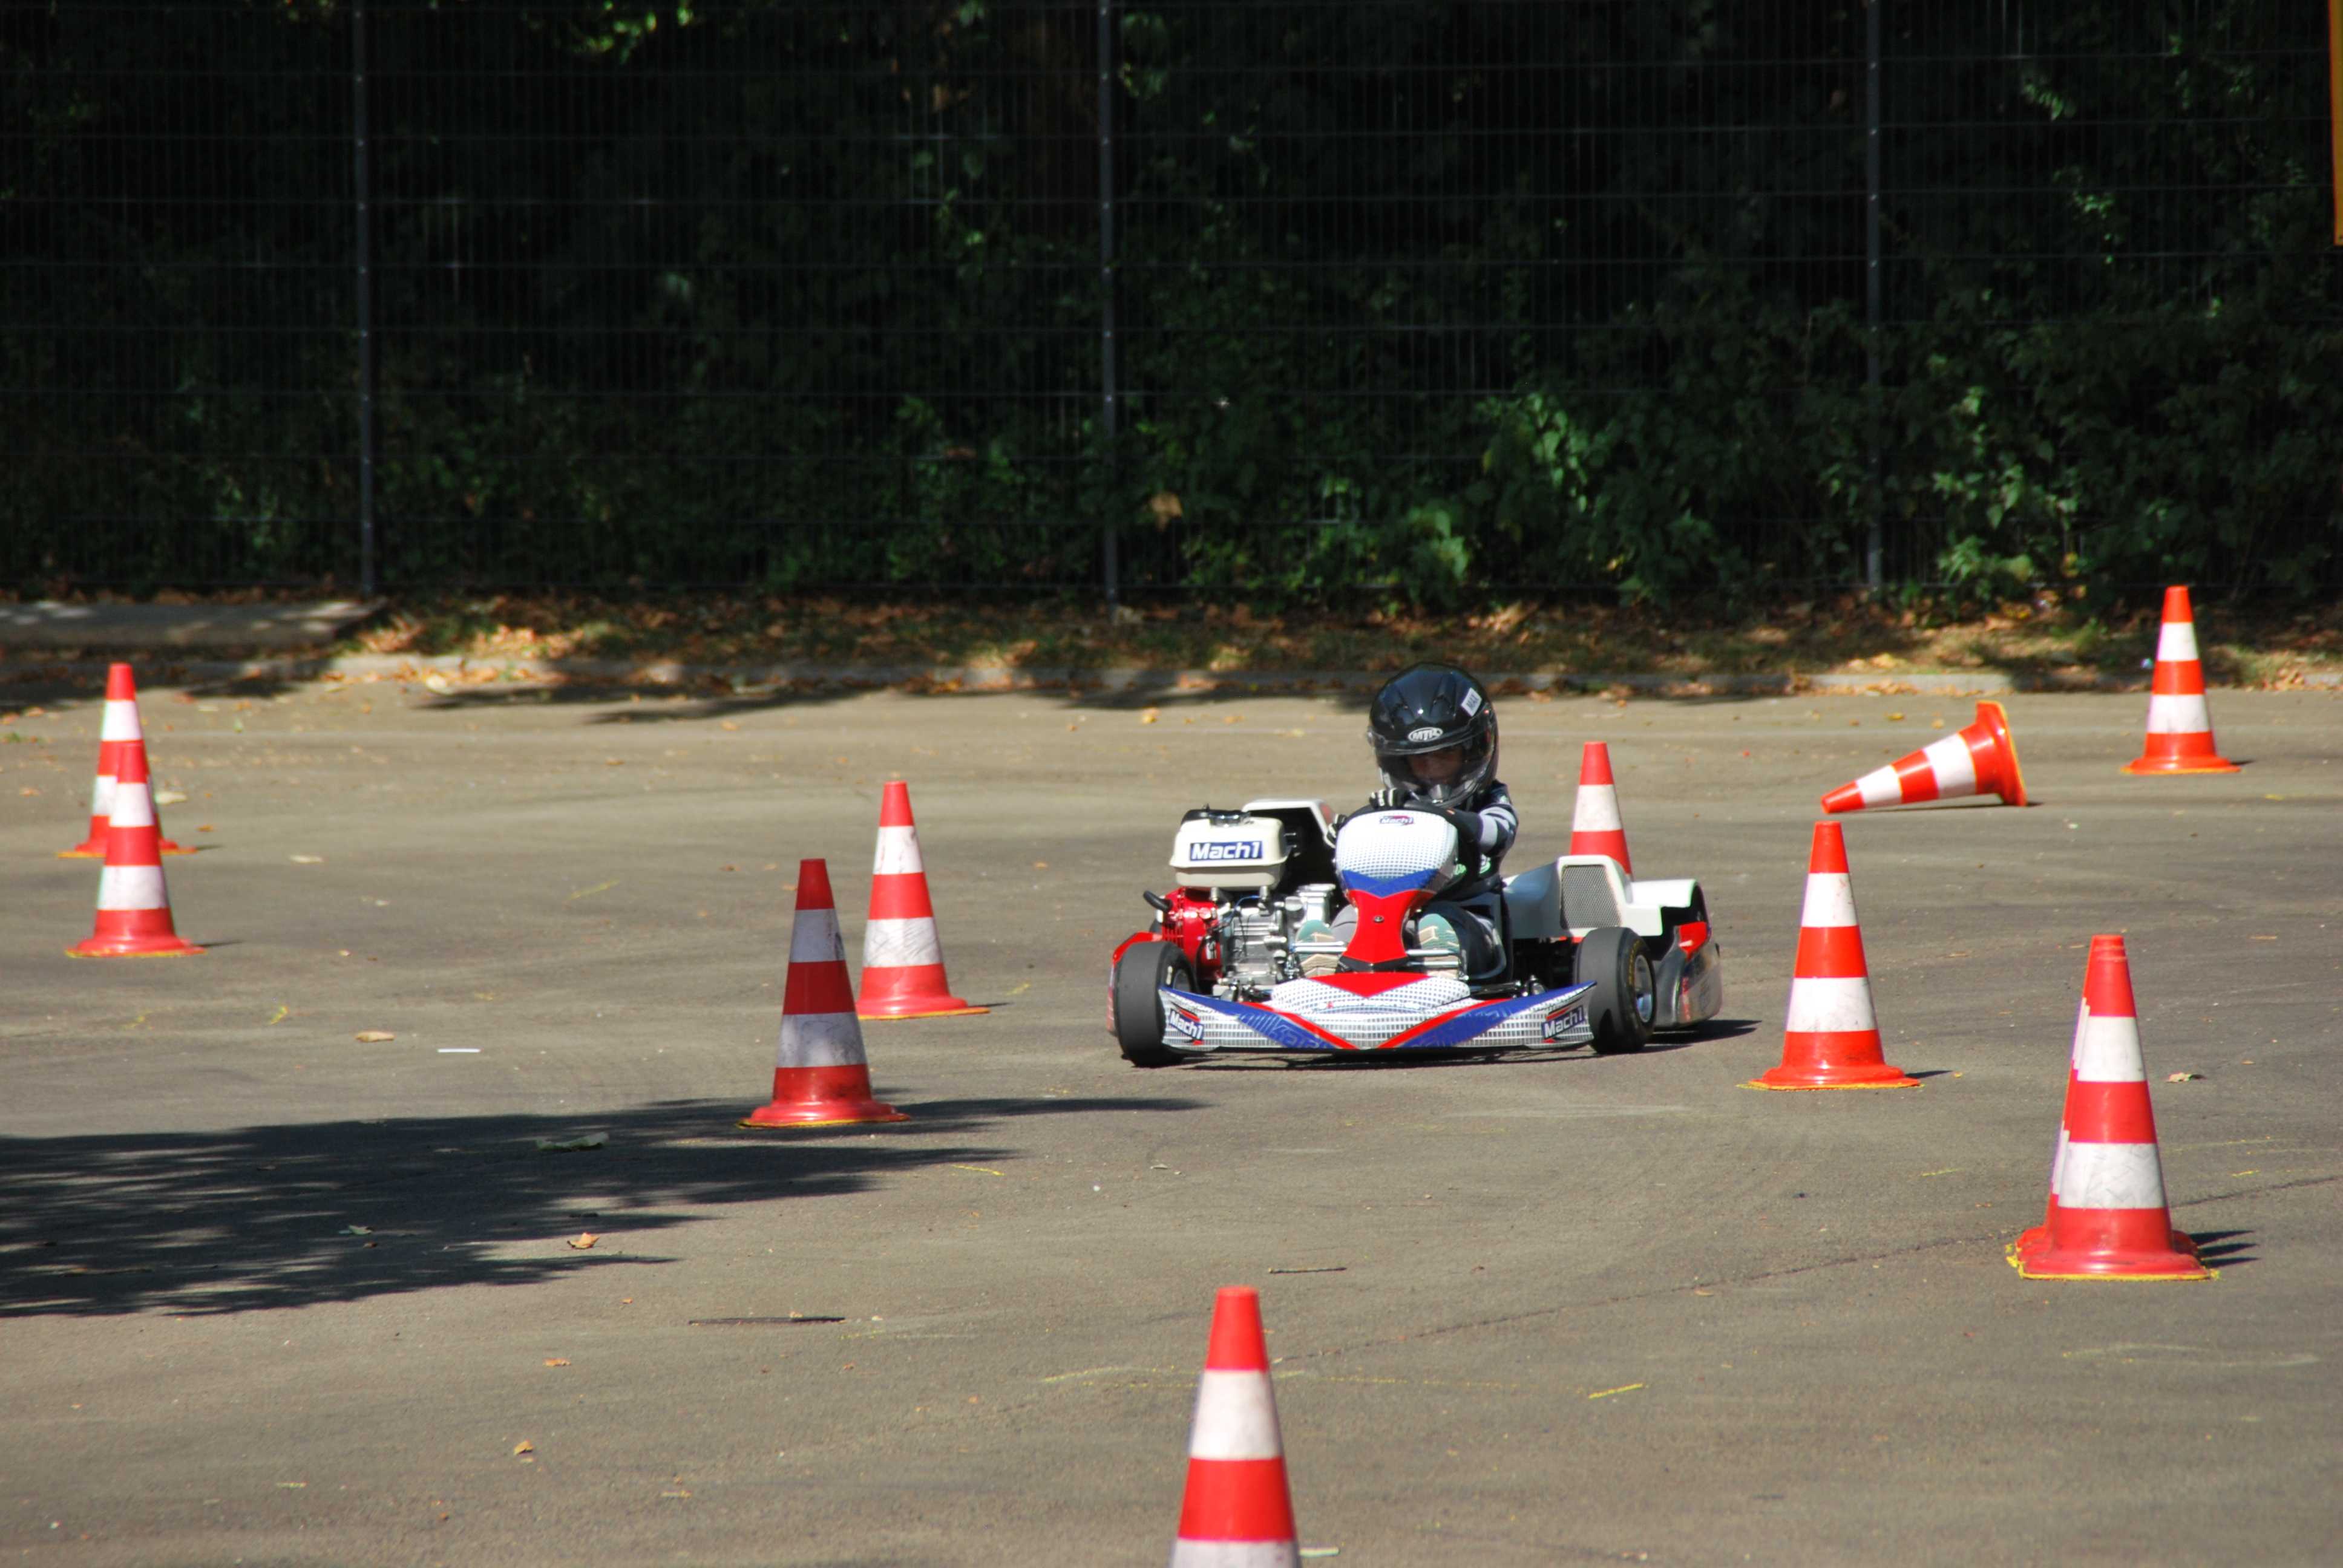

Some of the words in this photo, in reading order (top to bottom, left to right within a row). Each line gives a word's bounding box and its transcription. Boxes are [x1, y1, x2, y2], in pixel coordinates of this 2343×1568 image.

[1191, 841, 1260, 860] Mach1
[1170, 1010, 1203, 1039] Mach1
[1544, 1008, 1584, 1039] Mach1
